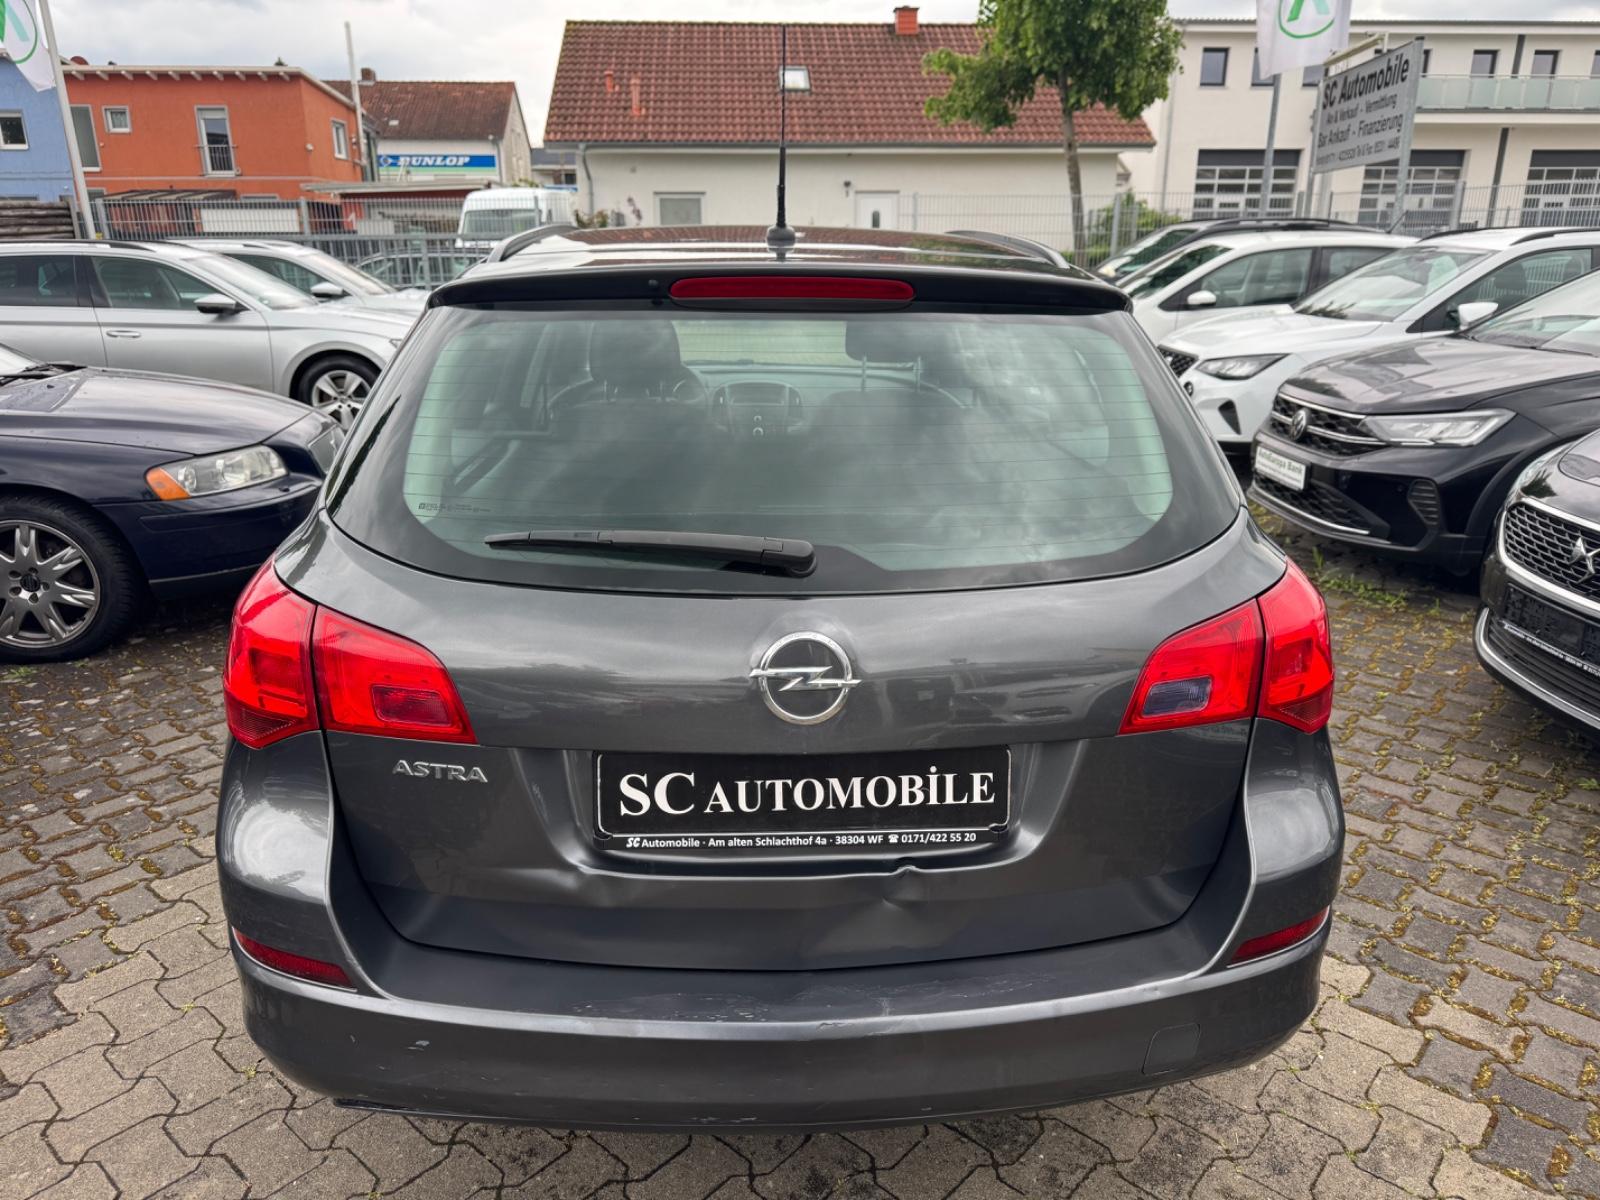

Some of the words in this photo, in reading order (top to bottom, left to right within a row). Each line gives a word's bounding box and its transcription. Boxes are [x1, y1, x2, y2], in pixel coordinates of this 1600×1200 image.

[1322, 80, 1337, 110] SC
[1339, 53, 1410, 104] Automobile
[1357, 113, 1404, 138] Finanzierung
[397, 156, 470, 166] DUNLOP
[392, 759, 489, 783] ASTRA
[620, 772, 695, 816] SC
[626, 837, 641, 848] SC
[641, 838, 700, 848] Automobile
[708, 837, 725, 847] Am
[727, 837, 753, 847] alten
[755, 836, 813, 847] Schlachthof
[814, 836, 827, 845] 4a
[835, 835, 865, 845] 38304
[867, 834, 884, 844] WF
[901, 833, 947, 844] 0171/422
[950, 832, 962, 842] 55
[964, 832, 976, 842] 20
